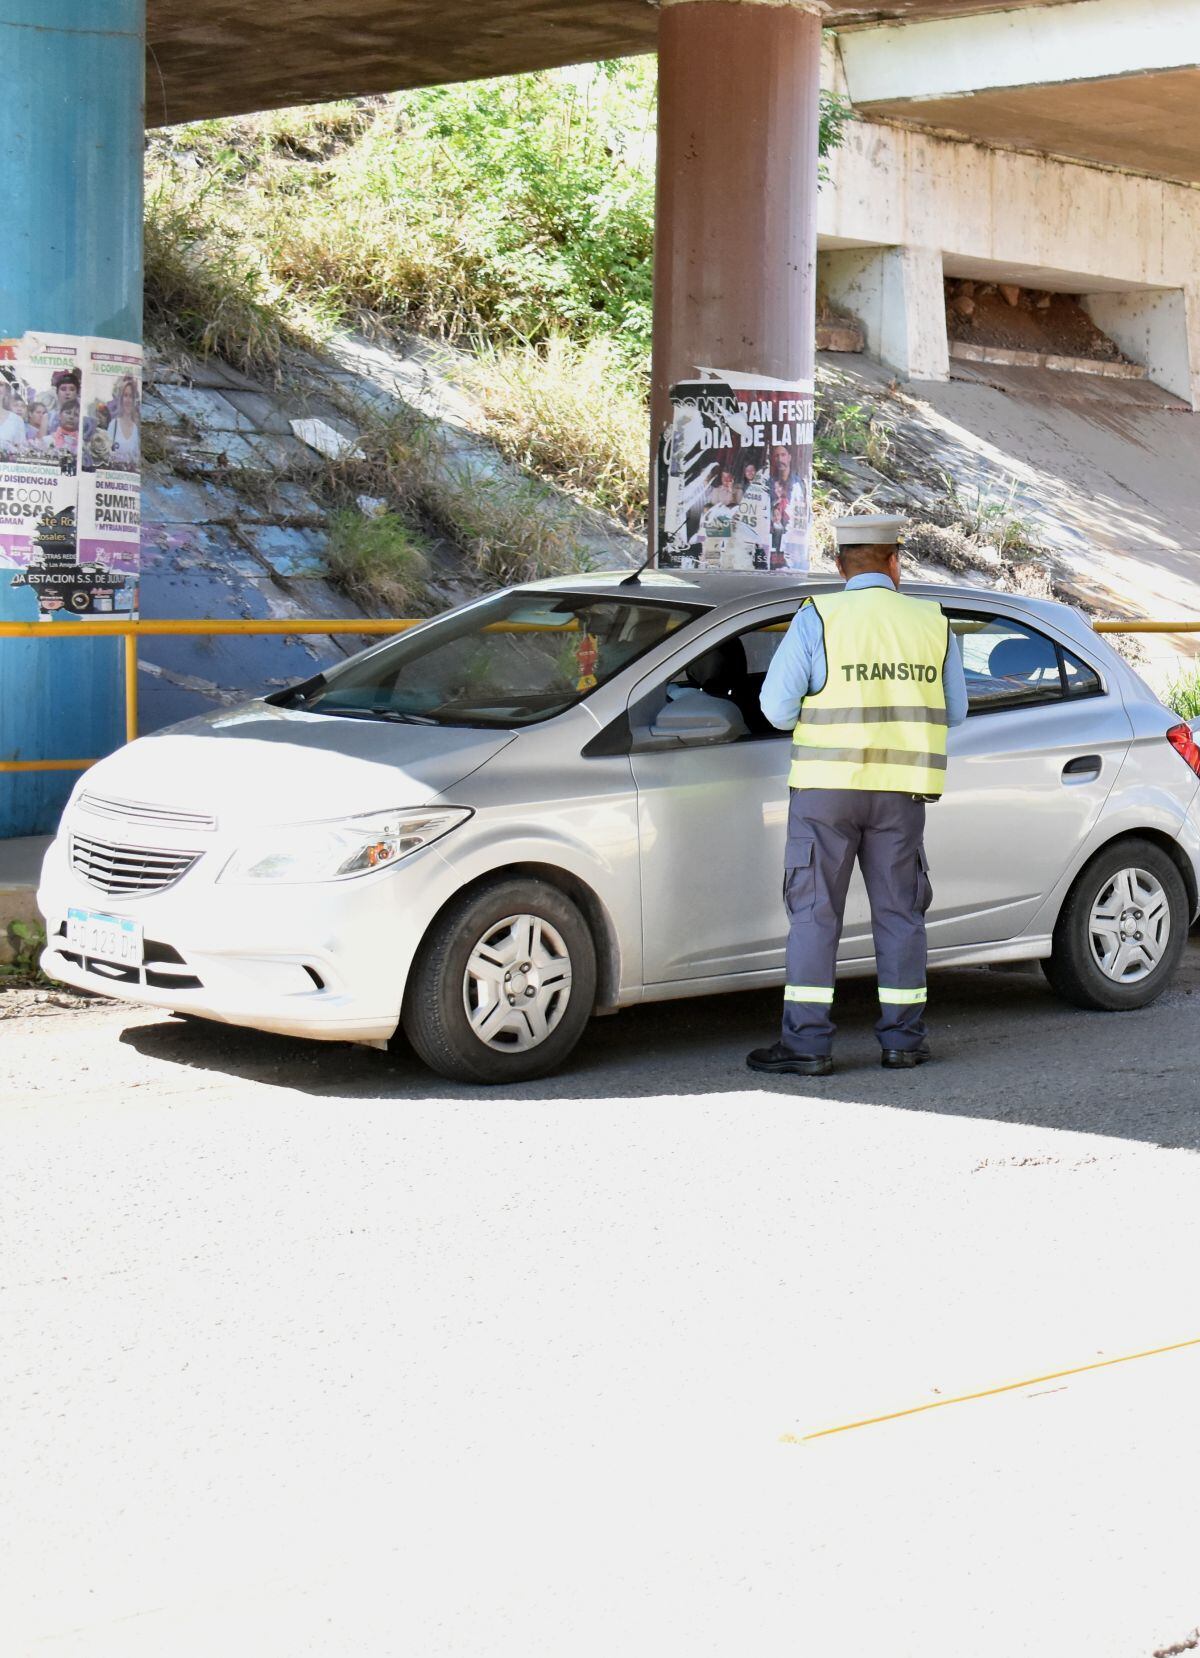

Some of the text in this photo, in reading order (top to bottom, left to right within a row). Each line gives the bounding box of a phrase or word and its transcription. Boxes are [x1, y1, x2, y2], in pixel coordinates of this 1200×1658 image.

[772, 424, 792, 445] LA
[4, 475, 58, 486] DISIDENCIAS
[17, 489, 52, 503] CON
[96, 509, 121, 523] PAN
[39, 533, 66, 541] osales
[28, 574, 75, 583] ESTACION
[95, 575, 107, 583] DE
[841, 663, 938, 683] TRANSITO
[91, 928, 116, 954] 123
